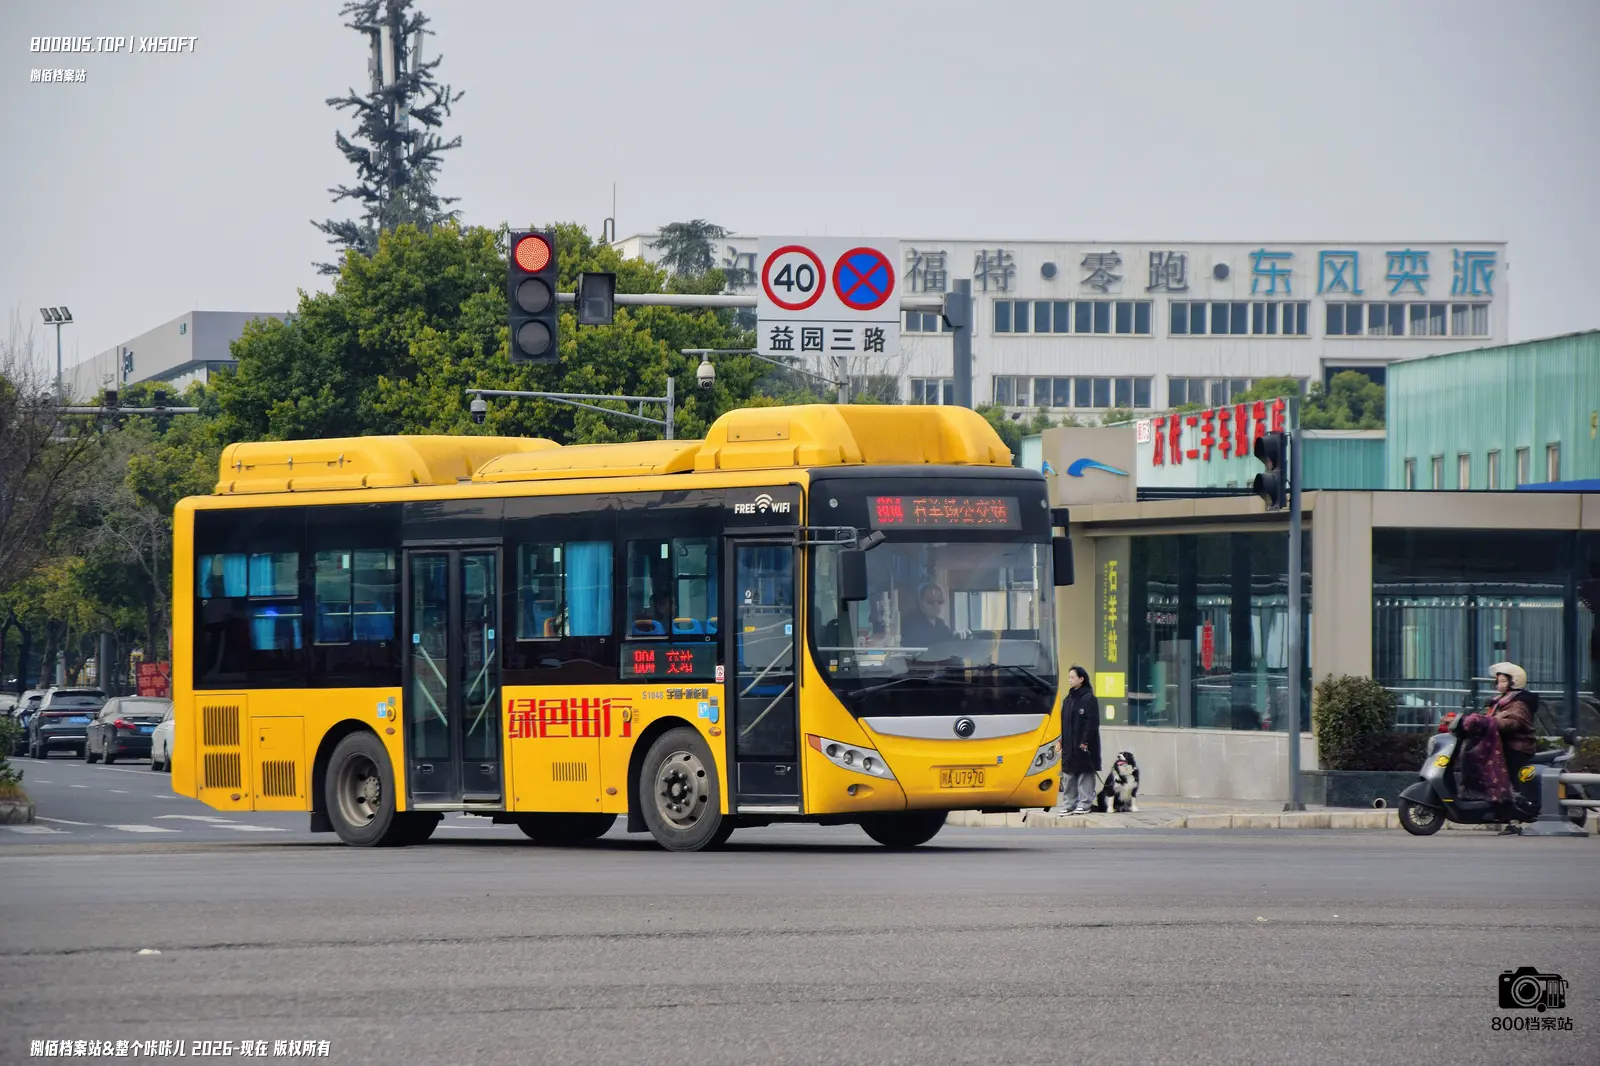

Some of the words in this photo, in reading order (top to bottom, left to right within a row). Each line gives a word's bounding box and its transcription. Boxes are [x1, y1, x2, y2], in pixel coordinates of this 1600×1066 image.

[773, 262, 816, 293] 40
[769, 325, 887, 353] 益园三路
[734, 503, 756, 514] FREE
[771, 502, 790, 513] WIFI
[642, 690, 664, 700] S1048
[507, 697, 633, 739] 绿色出行
